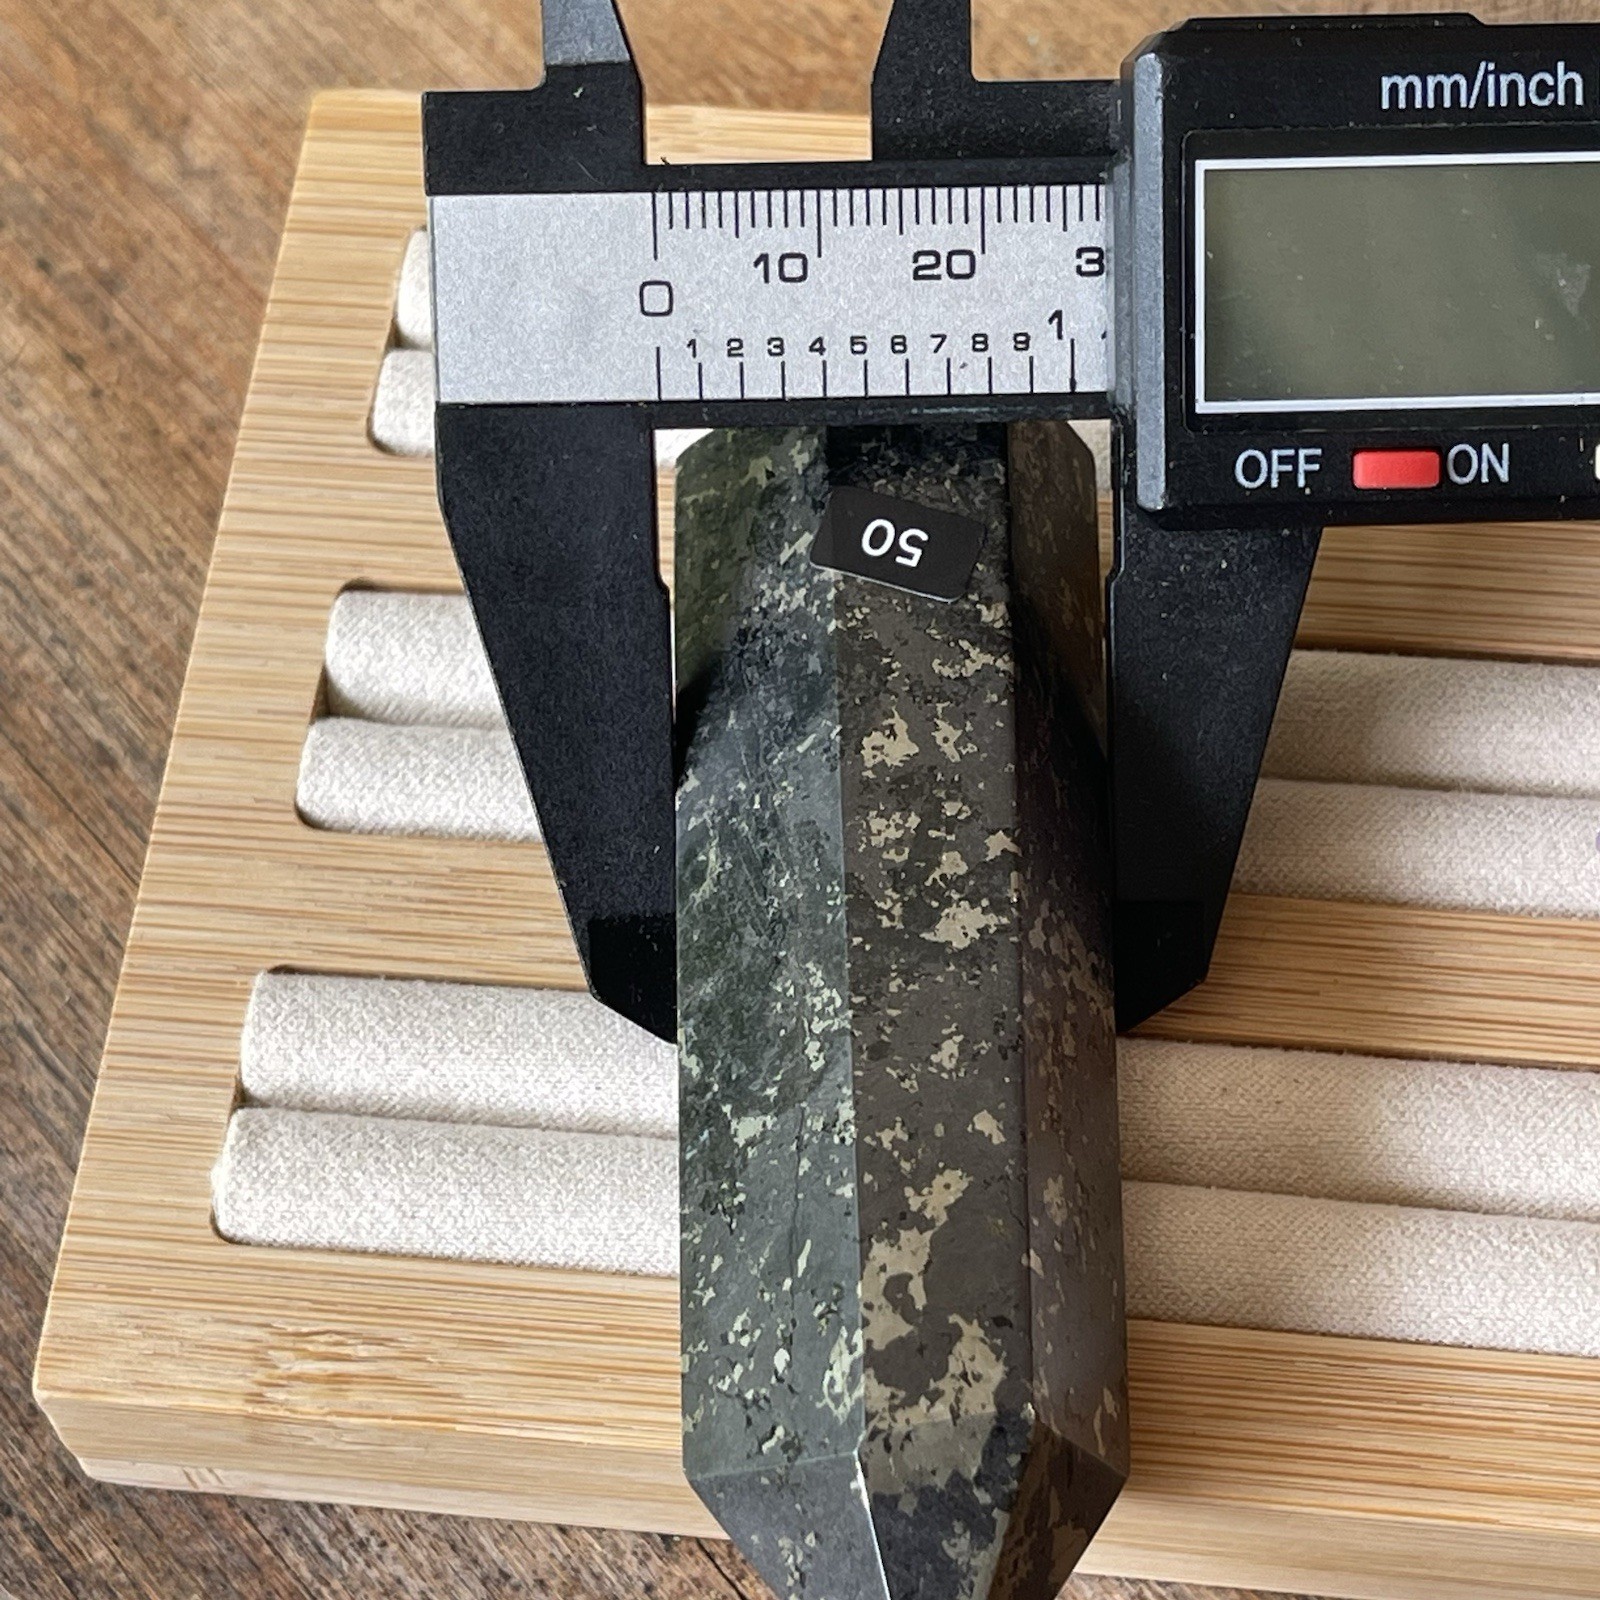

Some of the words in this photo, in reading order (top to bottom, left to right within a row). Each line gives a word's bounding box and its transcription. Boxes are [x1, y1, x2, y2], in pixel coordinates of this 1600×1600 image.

[1381, 60, 1584, 110] mm/inch
[753, 252, 809, 284] 10
[912, 249, 976, 281] 20
[1075, 246, 1105, 278] 3
[638, 280, 674, 317] 0
[686, 338, 697, 359] 1
[726, 337, 744, 358] 2
[767, 336, 785, 357] 3
[808, 336, 827, 356] 4
[849, 335, 868, 355] 5
[890, 334, 908, 355] 6
[929, 333, 948, 354] 7
[971, 332, 989, 353] 8
[1012, 332, 1031, 352] 9
[1047, 309, 1063, 341] 1
[1234, 447, 1322, 489] OFF
[1447, 442, 1510, 484] ON
[861, 518, 929, 568] 50
